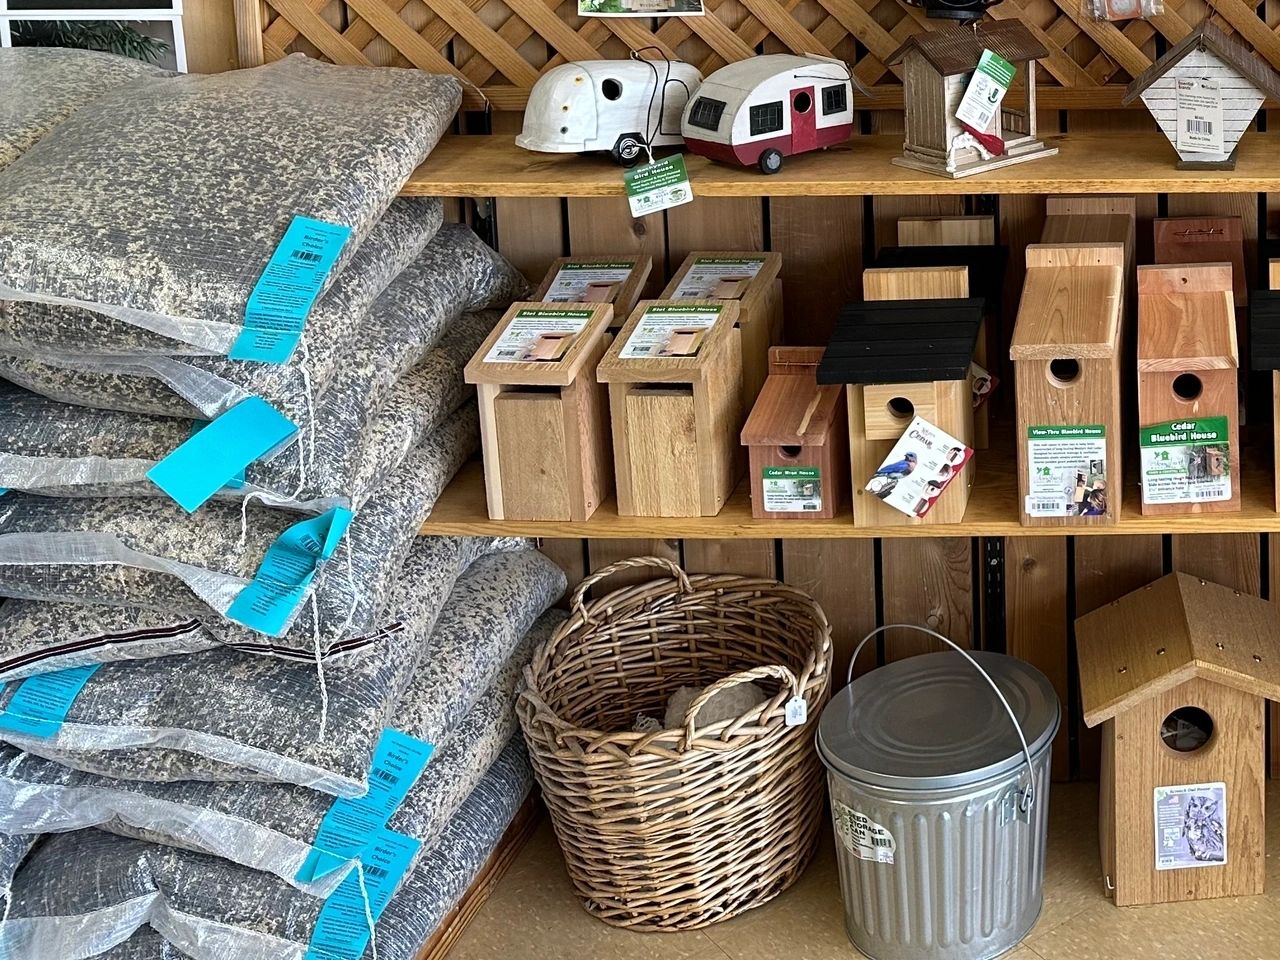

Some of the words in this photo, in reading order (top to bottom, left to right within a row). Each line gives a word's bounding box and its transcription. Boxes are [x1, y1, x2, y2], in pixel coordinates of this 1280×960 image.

[634, 171, 649, 180] Bird
[651, 165, 674, 175] House
[302, 241, 323, 250] Choice
[303, 234, 329, 245] Birder's
[1170, 422, 1196, 431] Cedar
[1150, 432, 1188, 442] Bluebird
[1190, 431, 1217, 440] House
[386, 751, 410, 765] Birder's
[383, 759, 403, 772] Choice
[847, 809, 868, 824] SEED
[849, 817, 885, 835] STORAGE
[850, 824, 866, 837] CAN
[374, 846, 397, 858] Birder's
[371, 854, 391, 865] Choice
